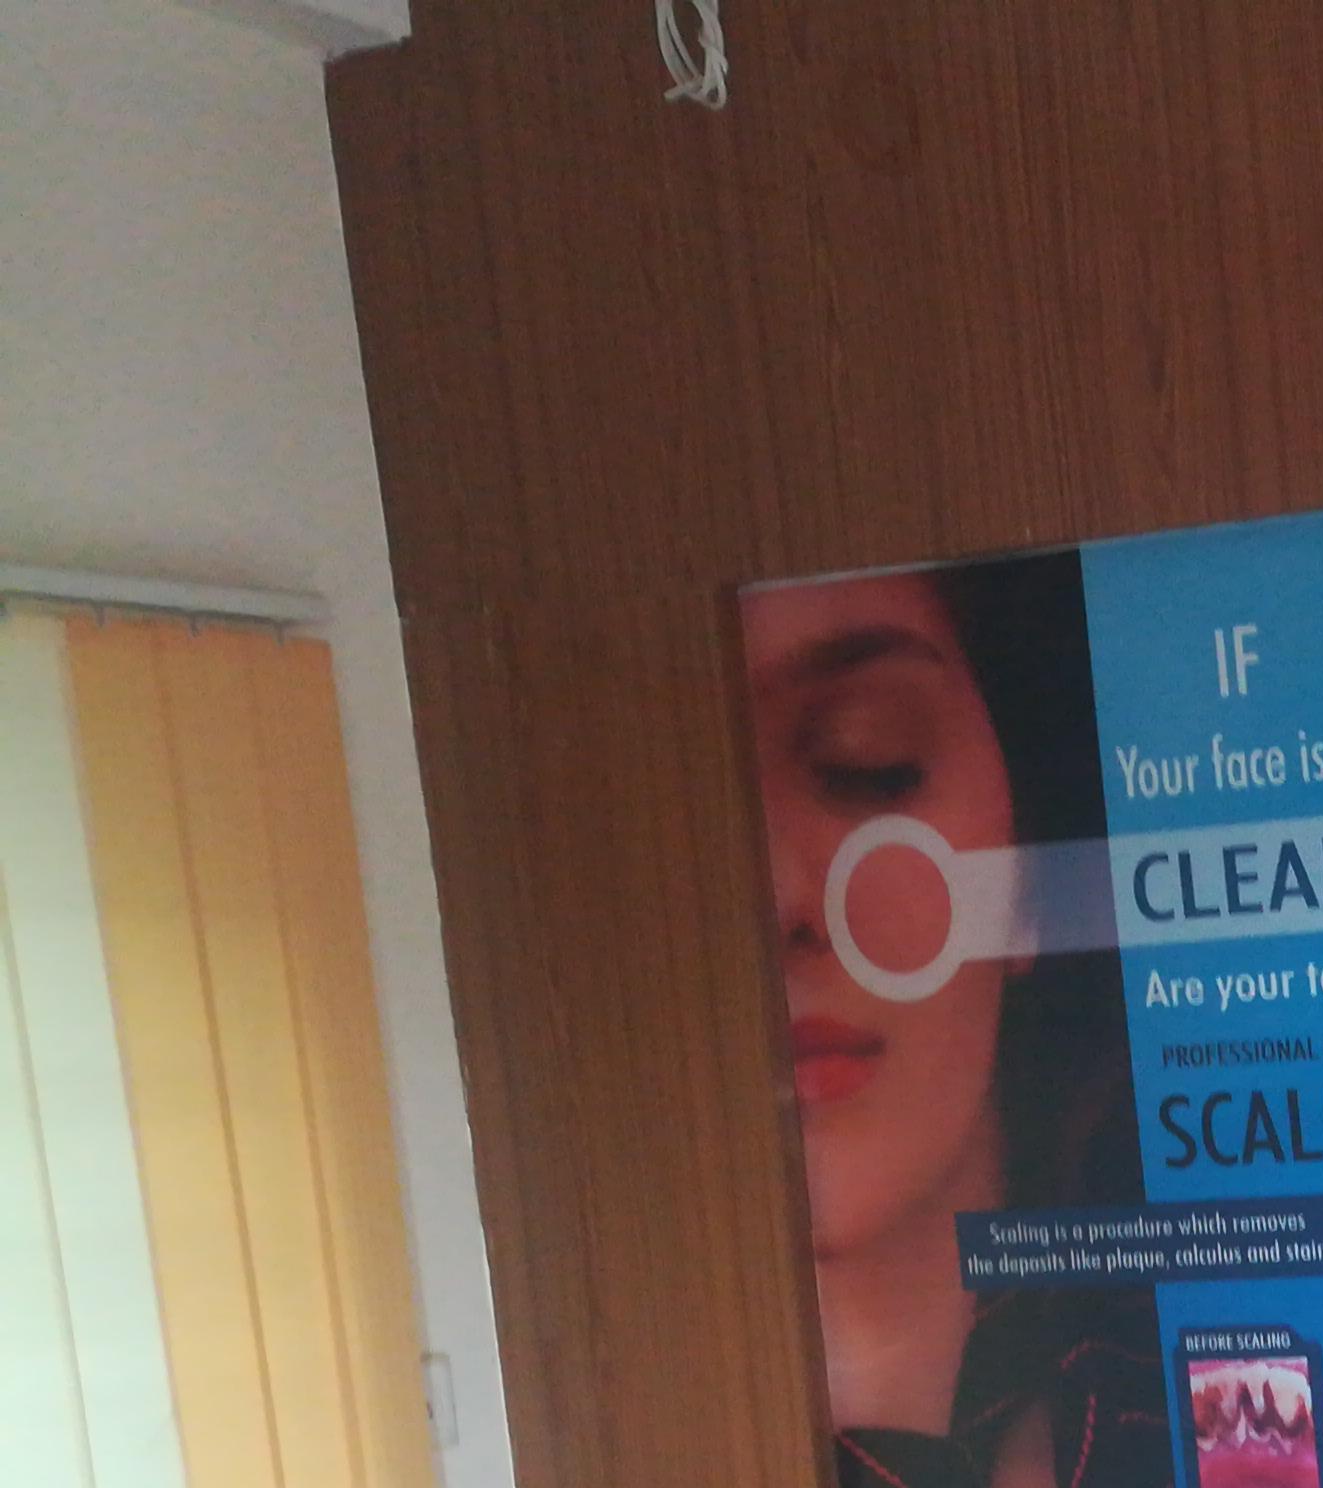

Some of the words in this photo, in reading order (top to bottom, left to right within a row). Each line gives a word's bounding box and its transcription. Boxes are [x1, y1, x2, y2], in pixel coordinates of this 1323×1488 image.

[1214, 624, 1259, 697] IF
[1116, 743, 1199, 799] Your
[1212, 733, 1287, 791] face
[1145, 968, 1204, 1008] Are
[1216, 966, 1294, 1012] your
[1161, 1036, 1318, 1069] PROFESSIONAL
[989, 1221, 1050, 1247] Scaling
[1055, 1220, 1068, 1243] is
[1072, 1223, 1083, 1241] a
[1088, 1212, 1173, 1244] procedure
[1178, 1208, 1227, 1237] which
[1233, 1210, 1306, 1233] removes
[967, 1252, 994, 1276] the
[998, 1250, 1066, 1277] deposits
[1070, 1246, 1101, 1272] like
[1106, 1244, 1171, 1273] plaque,
[1174, 1241, 1242, 1265] calculus
[1247, 1240, 1280, 1263] and
[1237, 1330, 1292, 1350] SCALING
